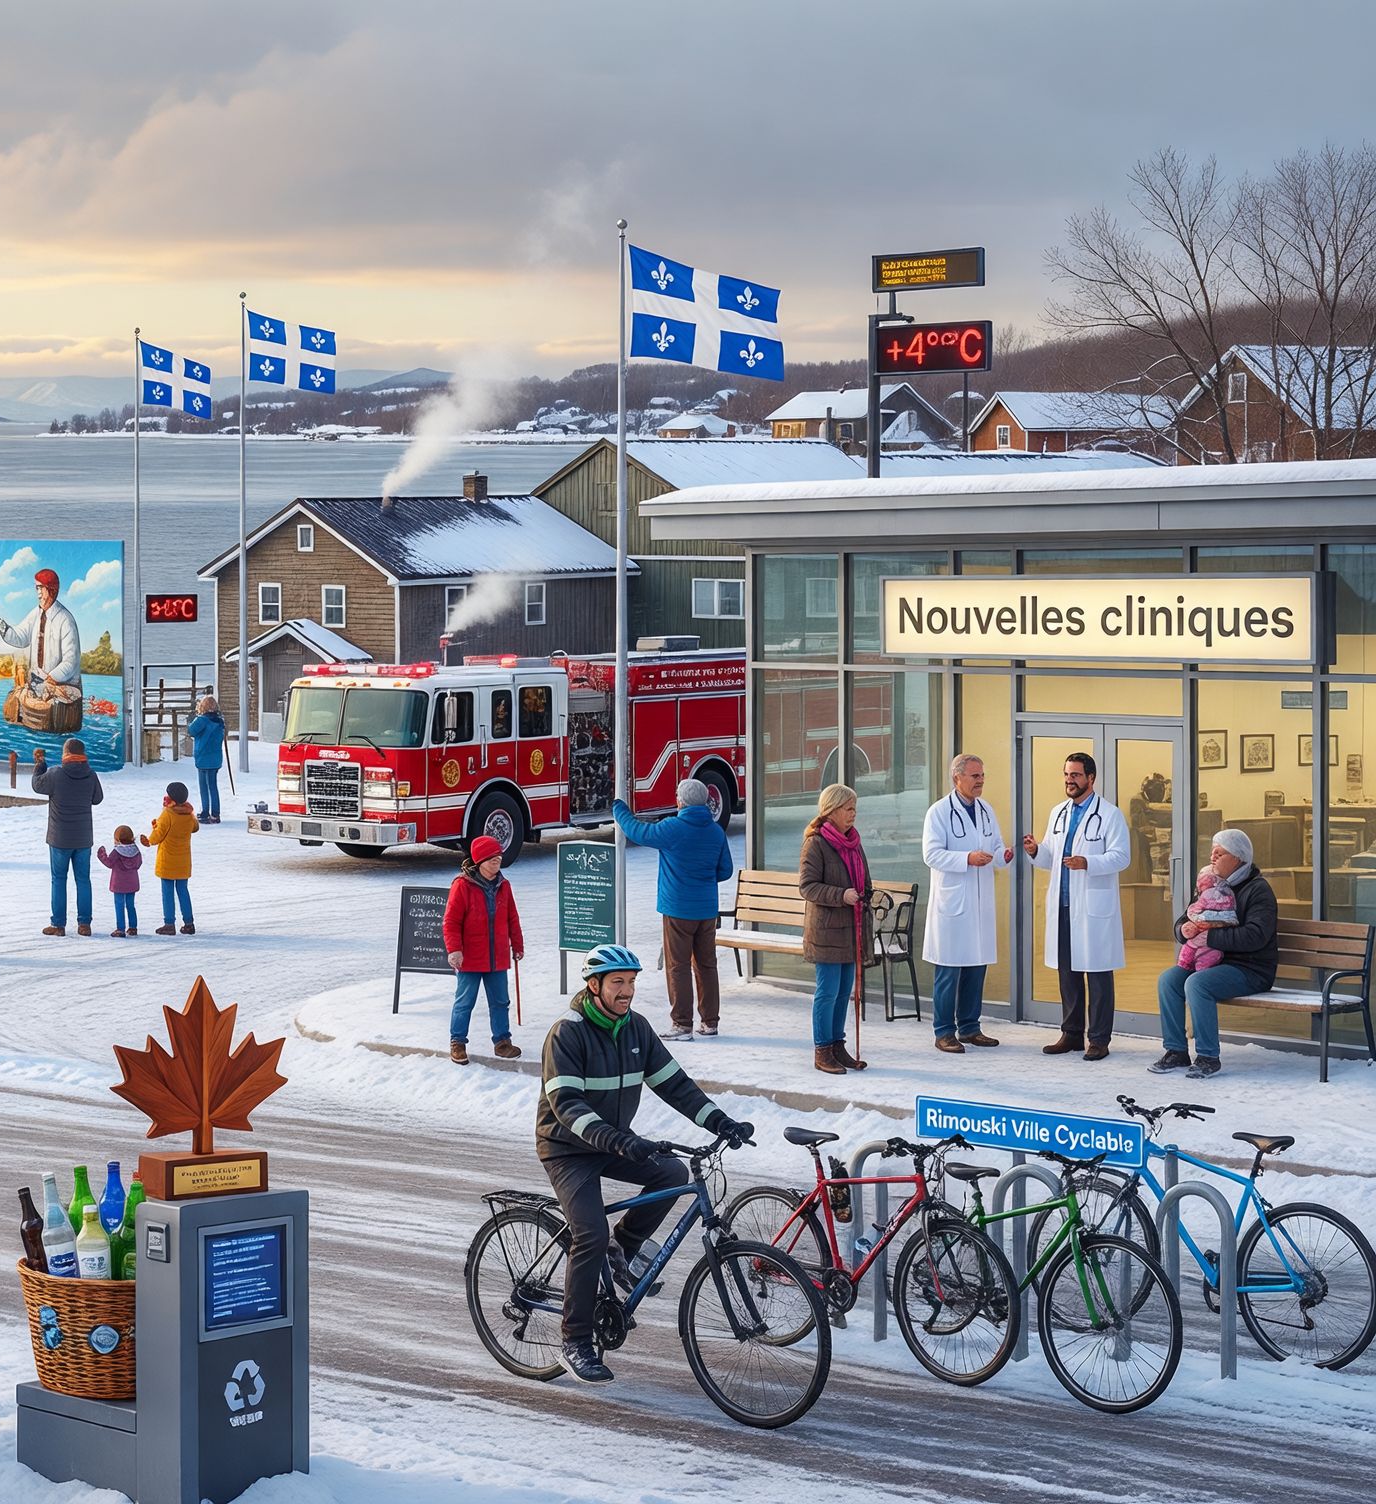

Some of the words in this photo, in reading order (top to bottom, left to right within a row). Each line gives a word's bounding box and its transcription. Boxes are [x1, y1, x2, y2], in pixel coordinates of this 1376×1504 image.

[899, 595, 1086, 636] Nouvelles
[1101, 595, 1295, 647] cliniques
[926, 1108, 1007, 1136] Rimouski
[1011, 1119, 1050, 1143] Ville
[1055, 1124, 1134, 1153] Cyclable
